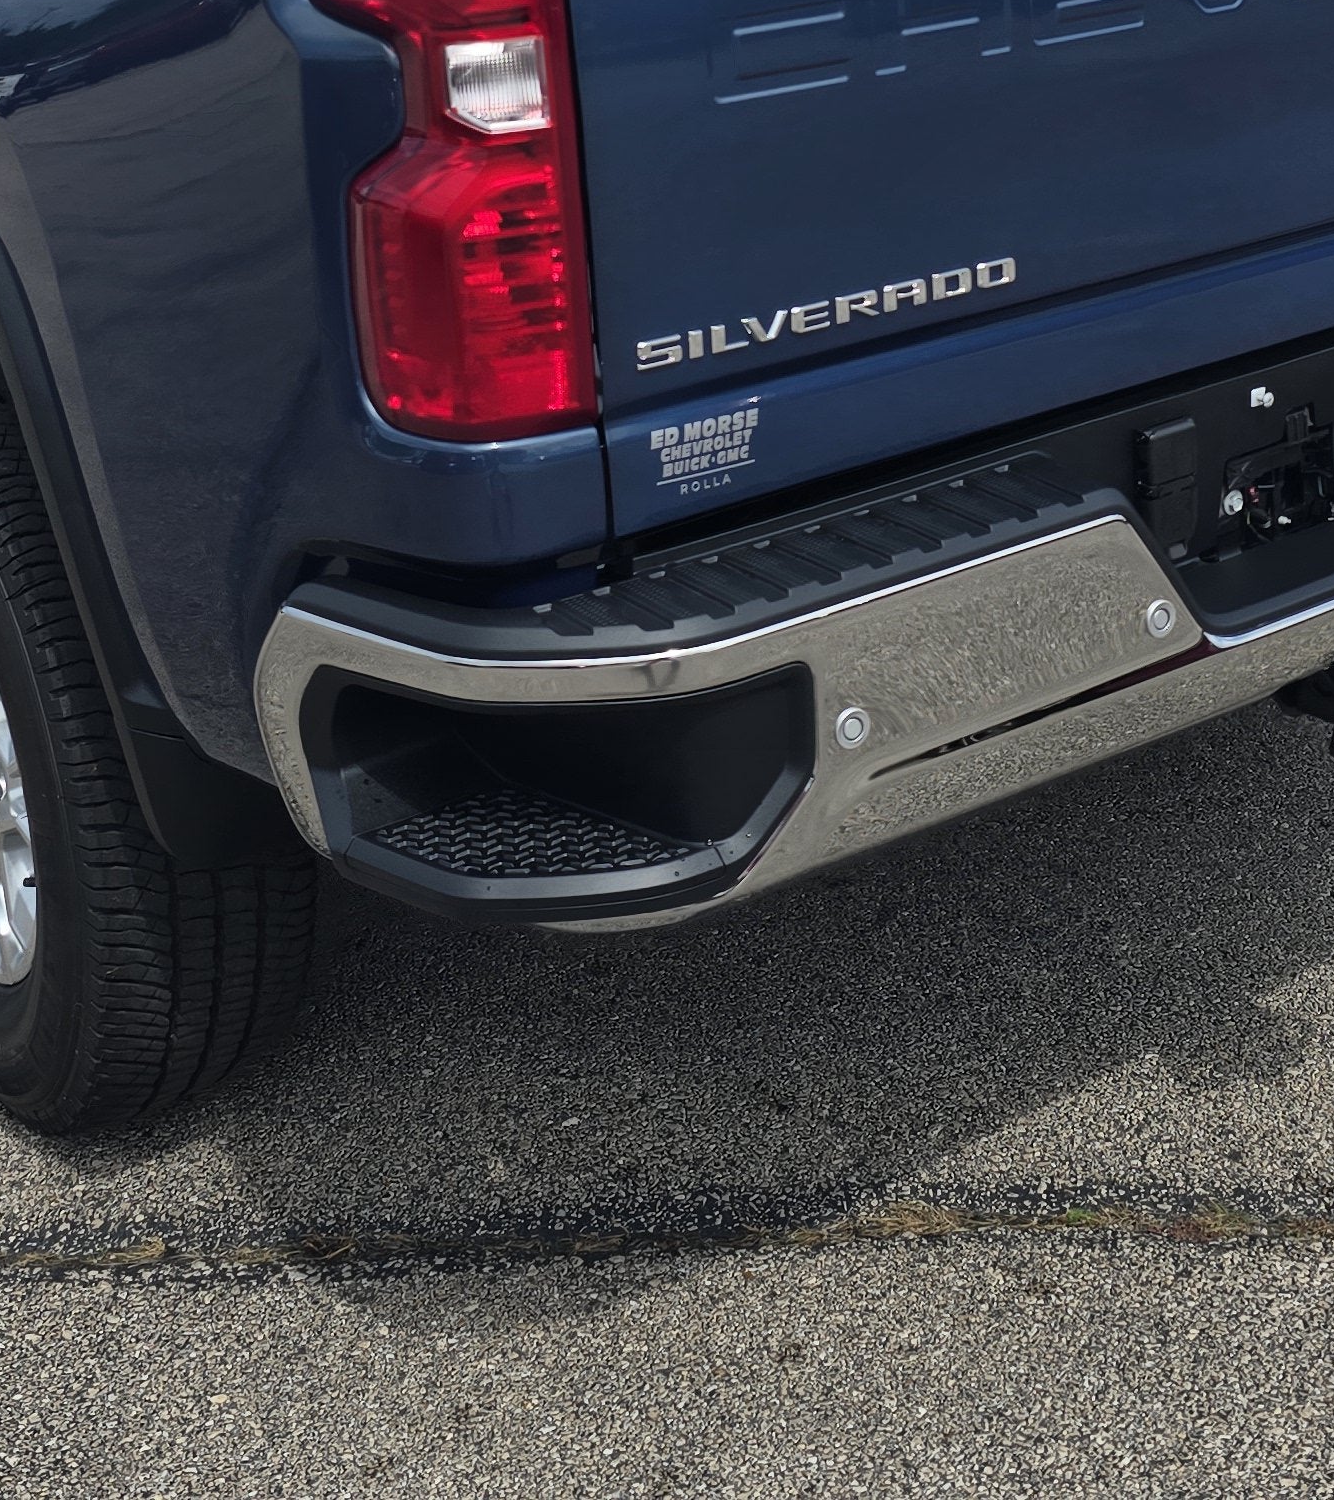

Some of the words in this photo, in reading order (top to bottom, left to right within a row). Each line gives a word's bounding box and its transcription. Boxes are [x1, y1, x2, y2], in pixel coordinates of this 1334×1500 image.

[636, 256, 1017, 371] SILVERADO
[650, 426, 679, 450] ED
[683, 407, 760, 443] MORSE
[660, 429, 753, 463] CHEVROLET
[680, 473, 732, 496] ROLLA
